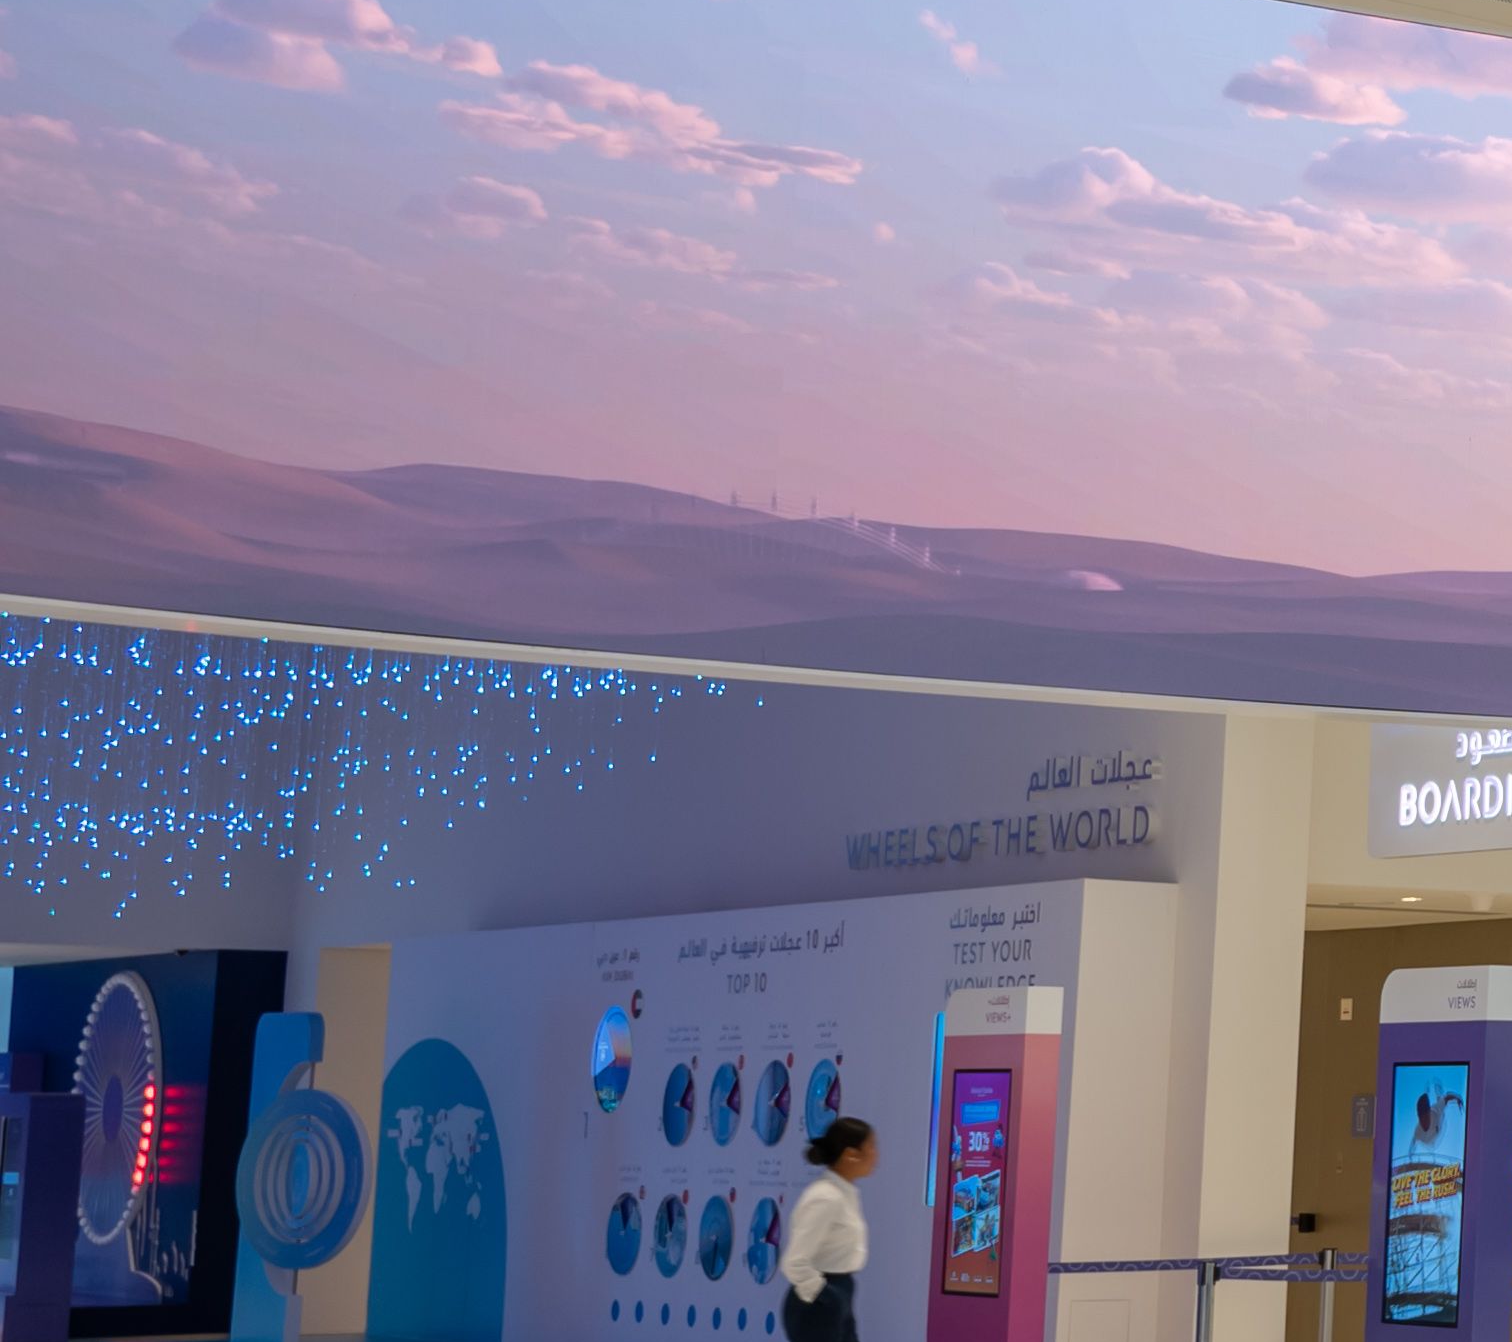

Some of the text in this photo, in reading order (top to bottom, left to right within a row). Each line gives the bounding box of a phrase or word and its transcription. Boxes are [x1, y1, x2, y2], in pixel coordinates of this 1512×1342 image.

[1026, 750, 1153, 801] عجلات العالم
[845, 806, 1150, 870] WHEELS OF THE WORLD
[950, 901, 1041, 932] اختبر معلوماتك
[769, 931, 802, 955] عجلات
[806, 929, 819, 949] 10
[823, 920, 845, 954] أكبر
[953, 939, 1031, 965] TEST YOUR
[727, 972, 767, 995] TOP 10
[1448, 996, 1476, 1009] VIEWS
[1392, 1175, 1412, 1192] LIVE
[1415, 1169, 1432, 1187] THE
[1395, 1191, 1413, 1208] FEEL
[1417, 1187, 1432, 1203] THE
